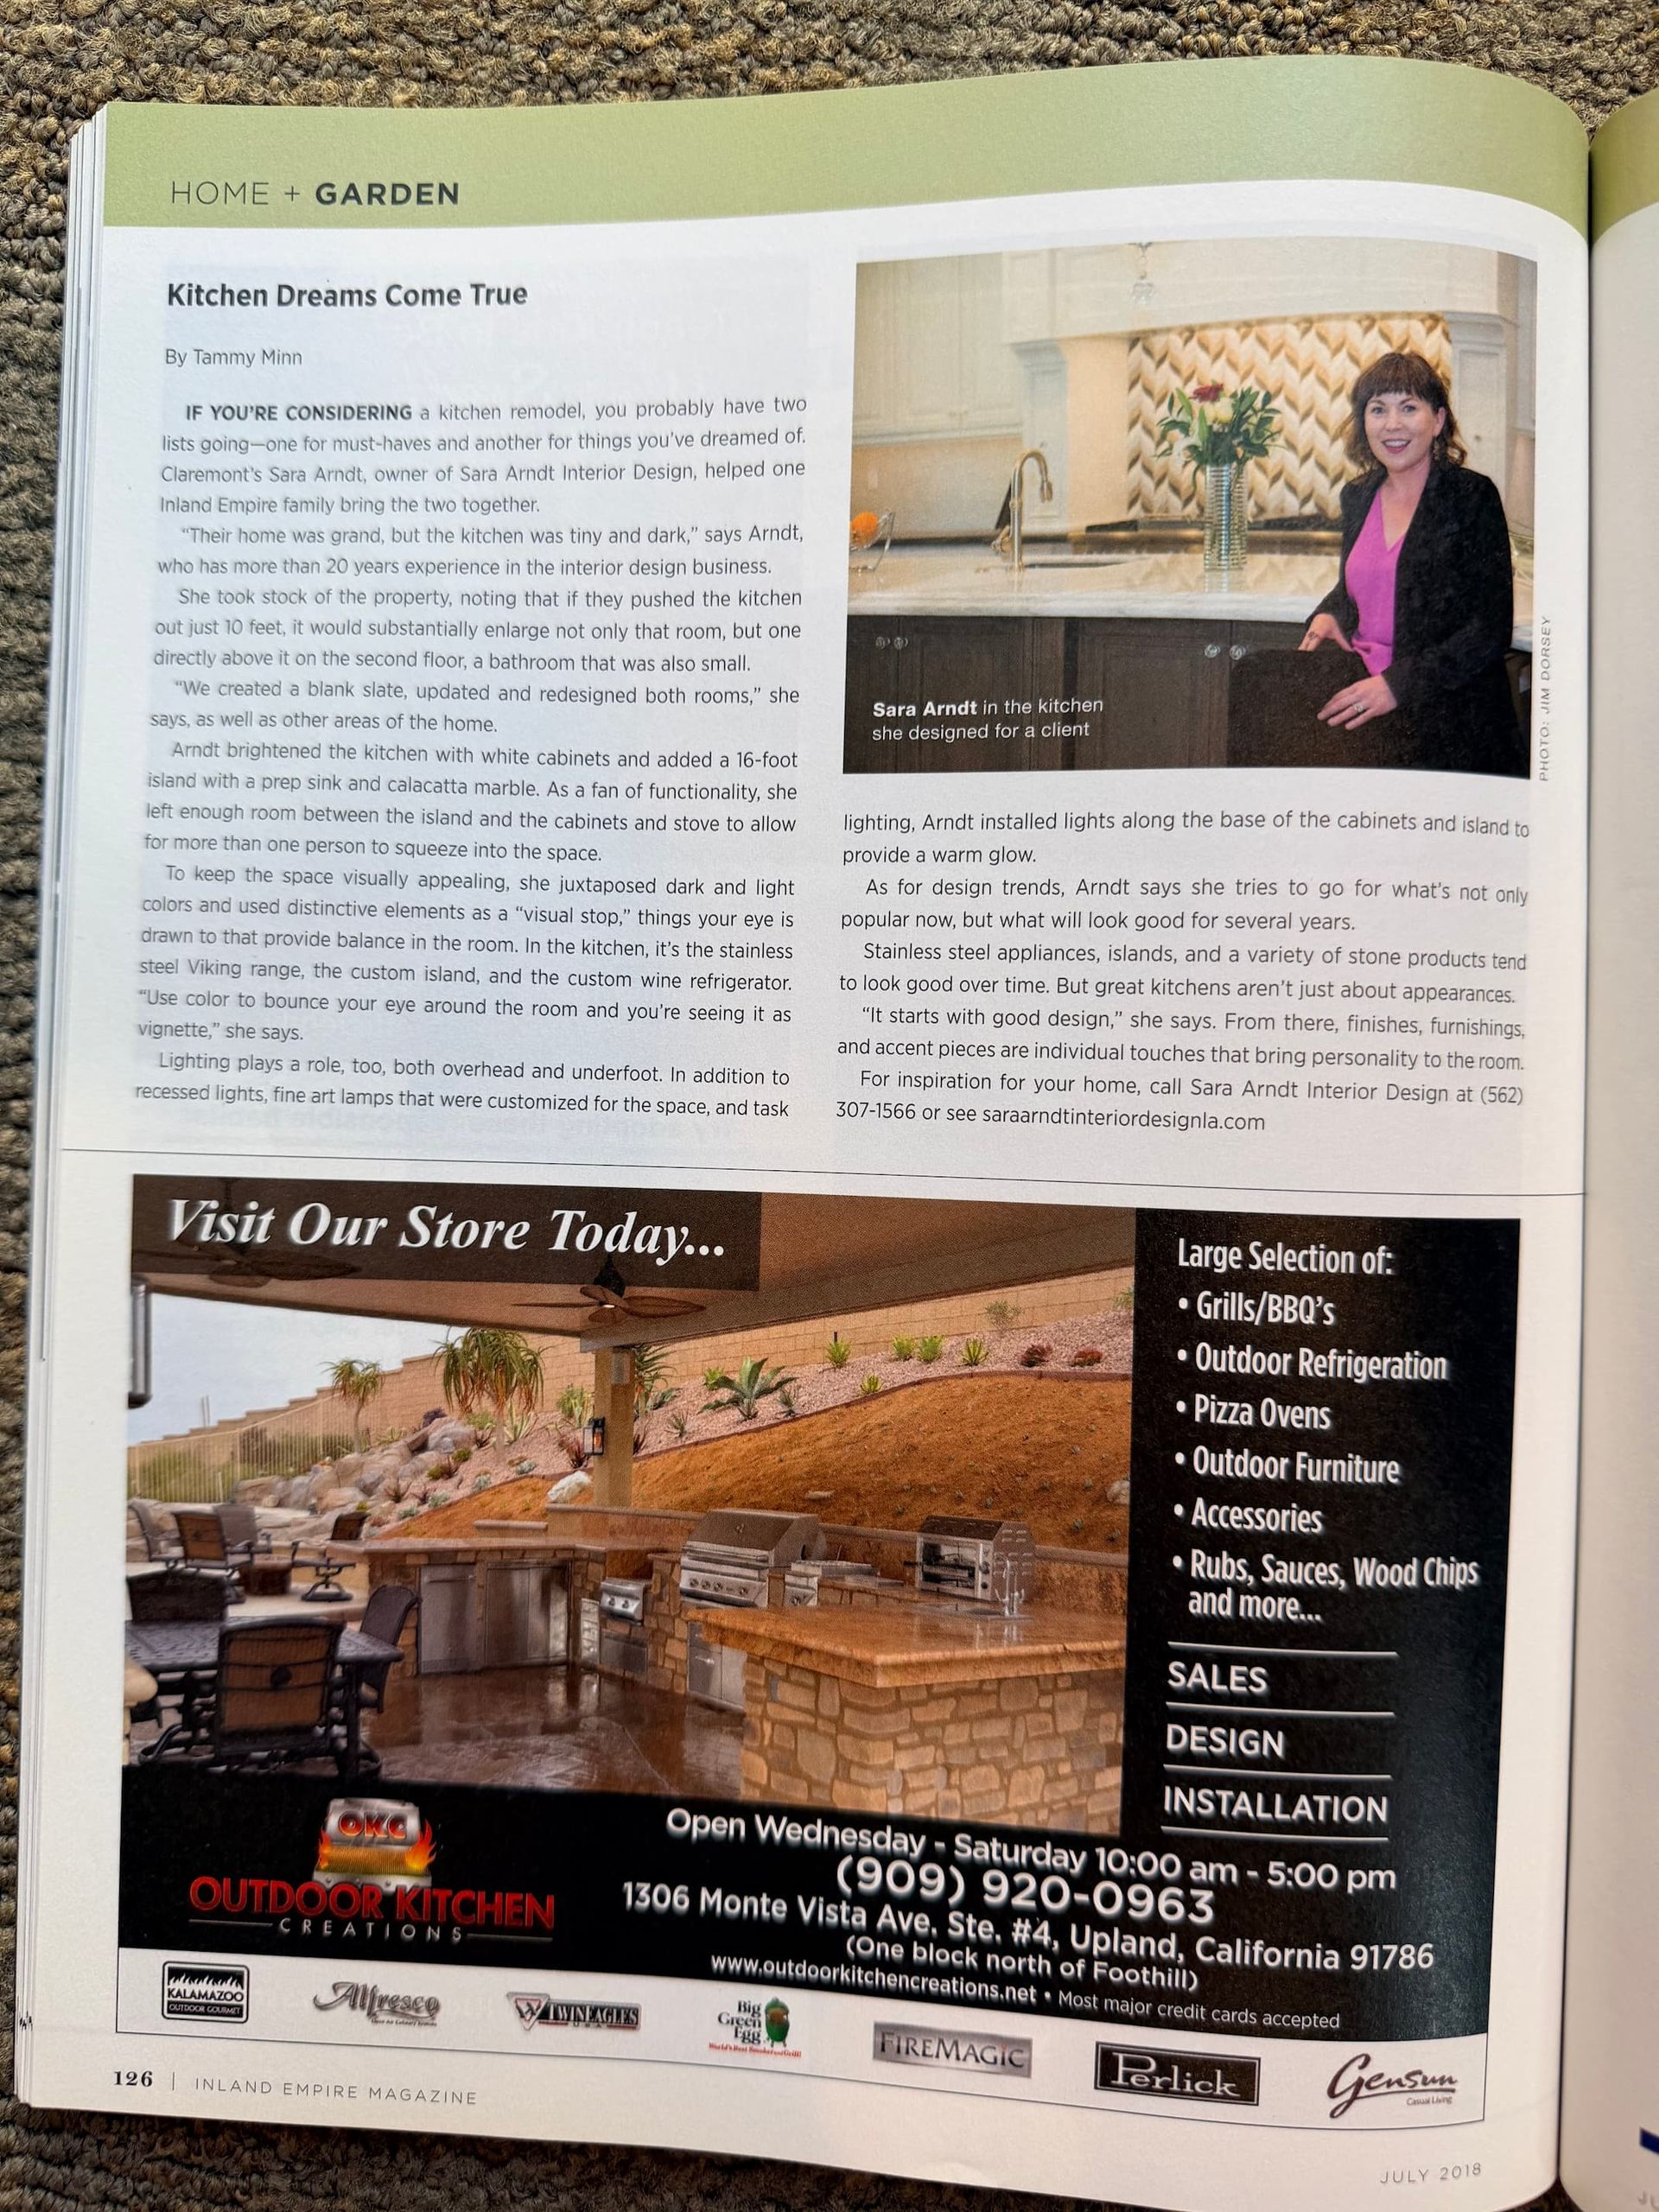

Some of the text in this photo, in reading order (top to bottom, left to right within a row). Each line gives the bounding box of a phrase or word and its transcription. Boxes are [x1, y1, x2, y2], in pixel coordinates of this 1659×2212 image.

[171, 181, 270, 206] HOME
[315, 181, 459, 207] GARDEN
[168, 282, 528, 308] Kitchen Dreams Come True
[165, 348, 302, 368] By Tammy Minn
[186, 397, 807, 422] IF YOU'RE CONSIDERING a kitchen remodel, you probably have two
[872, 696, 1103, 720] Sara Arndt in the kitchen
[1539, 615, 1551, 782] PHOTO: JIM DORSEY
[872, 719, 1090, 744] she designed for a client
[172, 741, 798, 769] Arndt brightened the kitchen with white cabinets and added a 16-foot
[863, 942, 1527, 971] Stainless steel appliances, islands, and a variety of stone products tend
[861, 1070, 1523, 1106] For inspiration for your home, call Sara Arndt Interior Design at (562)
[836, 1101, 1265, 1132] 307-1566 or see saraarndtinteriordesignla.com
[171, 1199, 276, 1244] Visit
[288, 1202, 389, 1246] Our
[397, 1205, 531, 1250] Store
[1178, 1237, 1394, 1275] Large Selection of:
[1197, 1290, 1336, 1326] Grills/BBQ's
[1195, 1341, 1448, 1384] Outdoor Refrigeration
[1194, 1393, 1332, 1430] Pizza Ovens
[1192, 1445, 1401, 1484] Outdoor Furniture
[1191, 1497, 1324, 1535] Accessories
[1191, 1548, 1479, 1591] Rubs, Sauces, Wood Chips
[1188, 1586, 1233, 1618] and
[1167, 1661, 1268, 1694] SALES
[1166, 1723, 1285, 1758] DESIGN
[1164, 1785, 1388, 1823] INSTALLATION
[339, 1811, 408, 1840] OKC
[666, 1808, 746, 1840] Open
[754, 1814, 926, 1859] Wednesday
[953, 1833, 1087, 1876] Saturday
[1095, 1847, 1182, 1880] 10:00
[1189, 1860, 1238, 1885] am
[1267, 1860, 1339, 1890] 5:00
[1347, 1869, 1396, 1895] pm
[189, 1876, 555, 1930] OUTDOOR KITCHEN
[836, 1854, 1214, 1925] (909) 920-0963
[279, 1918, 462, 1941] CREATIONS
[623, 1881, 1434, 1971] 1306 Monte Vista Ave. Ste. #4, Upland, California 91786
[846, 1935, 1198, 1993] (One block north of Foothill)
[167, 1987, 245, 2003] KALAMAZOO
[314, 1981, 441, 2018] Alfresco
[711, 1955, 1340, 2031] www.outdoorkitchencreations.net Most major credit cards accepted
[737, 2000, 761, 2017] Big
[717, 2012, 761, 2029] Green
[734, 2029, 761, 2045] Egg
[113, 2070, 154, 2088] 126
[195, 2077, 476, 2105] INLAND EMPIRE MAGAZINE
[1111, 2051, 1242, 2098] Perlick
[1326, 2052, 1458, 2119] Gensun
[1380, 2163, 1481, 2183] JULY 2018
